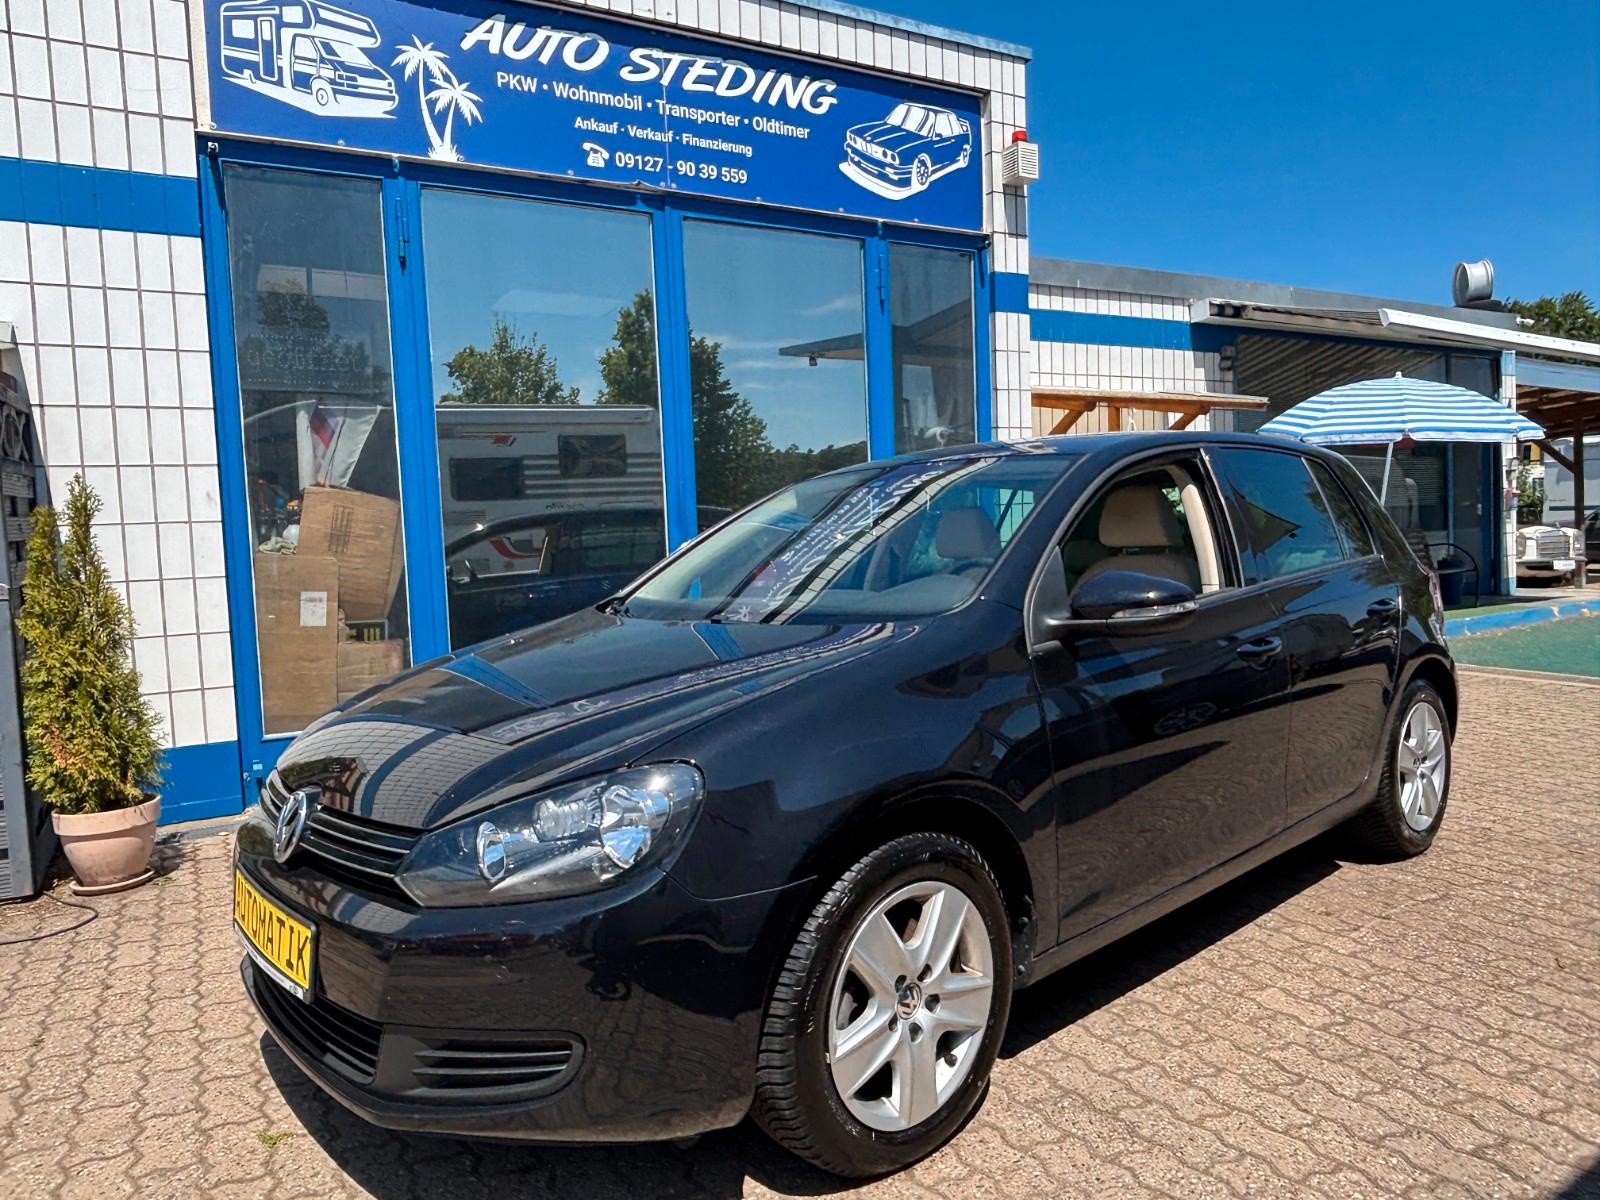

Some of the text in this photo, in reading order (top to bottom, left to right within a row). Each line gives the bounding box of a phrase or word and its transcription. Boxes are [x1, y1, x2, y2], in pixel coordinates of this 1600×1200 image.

[461, 15, 838, 115] AUTO STEDING
[496, 72, 810, 140] PKW Wohnmobil Transporter Oldtimer
[574, 116, 753, 158] Ankauf Verkauf Finanzierung
[615, 152, 663, 173] 09127
[677, 161, 696, 177] 90
[699, 164, 718, 180] 39
[721, 167, 748, 184] 559
[235, 877, 310, 981] AUTOMATIK
